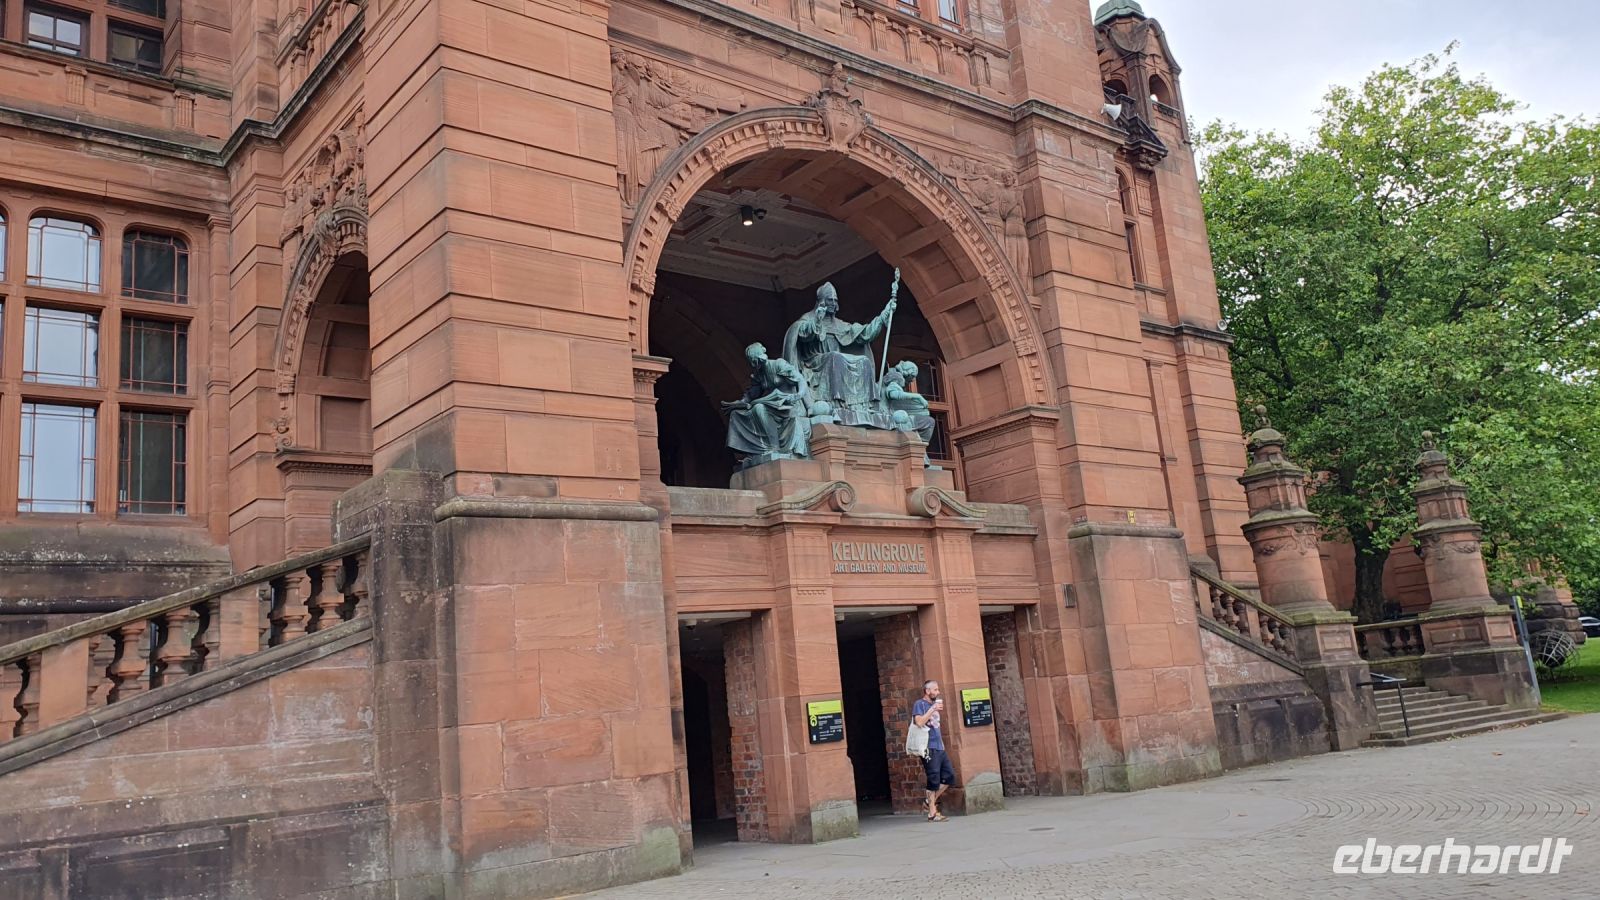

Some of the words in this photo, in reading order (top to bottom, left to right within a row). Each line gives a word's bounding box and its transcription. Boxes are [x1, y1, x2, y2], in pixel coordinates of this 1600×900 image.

[832, 541, 926, 562] KELVINGROVE
[834, 563, 849, 573] ART
[850, 562, 880, 573] GALLERY
[882, 563, 896, 573] AND
[898, 563, 927, 573] MUSEUM
